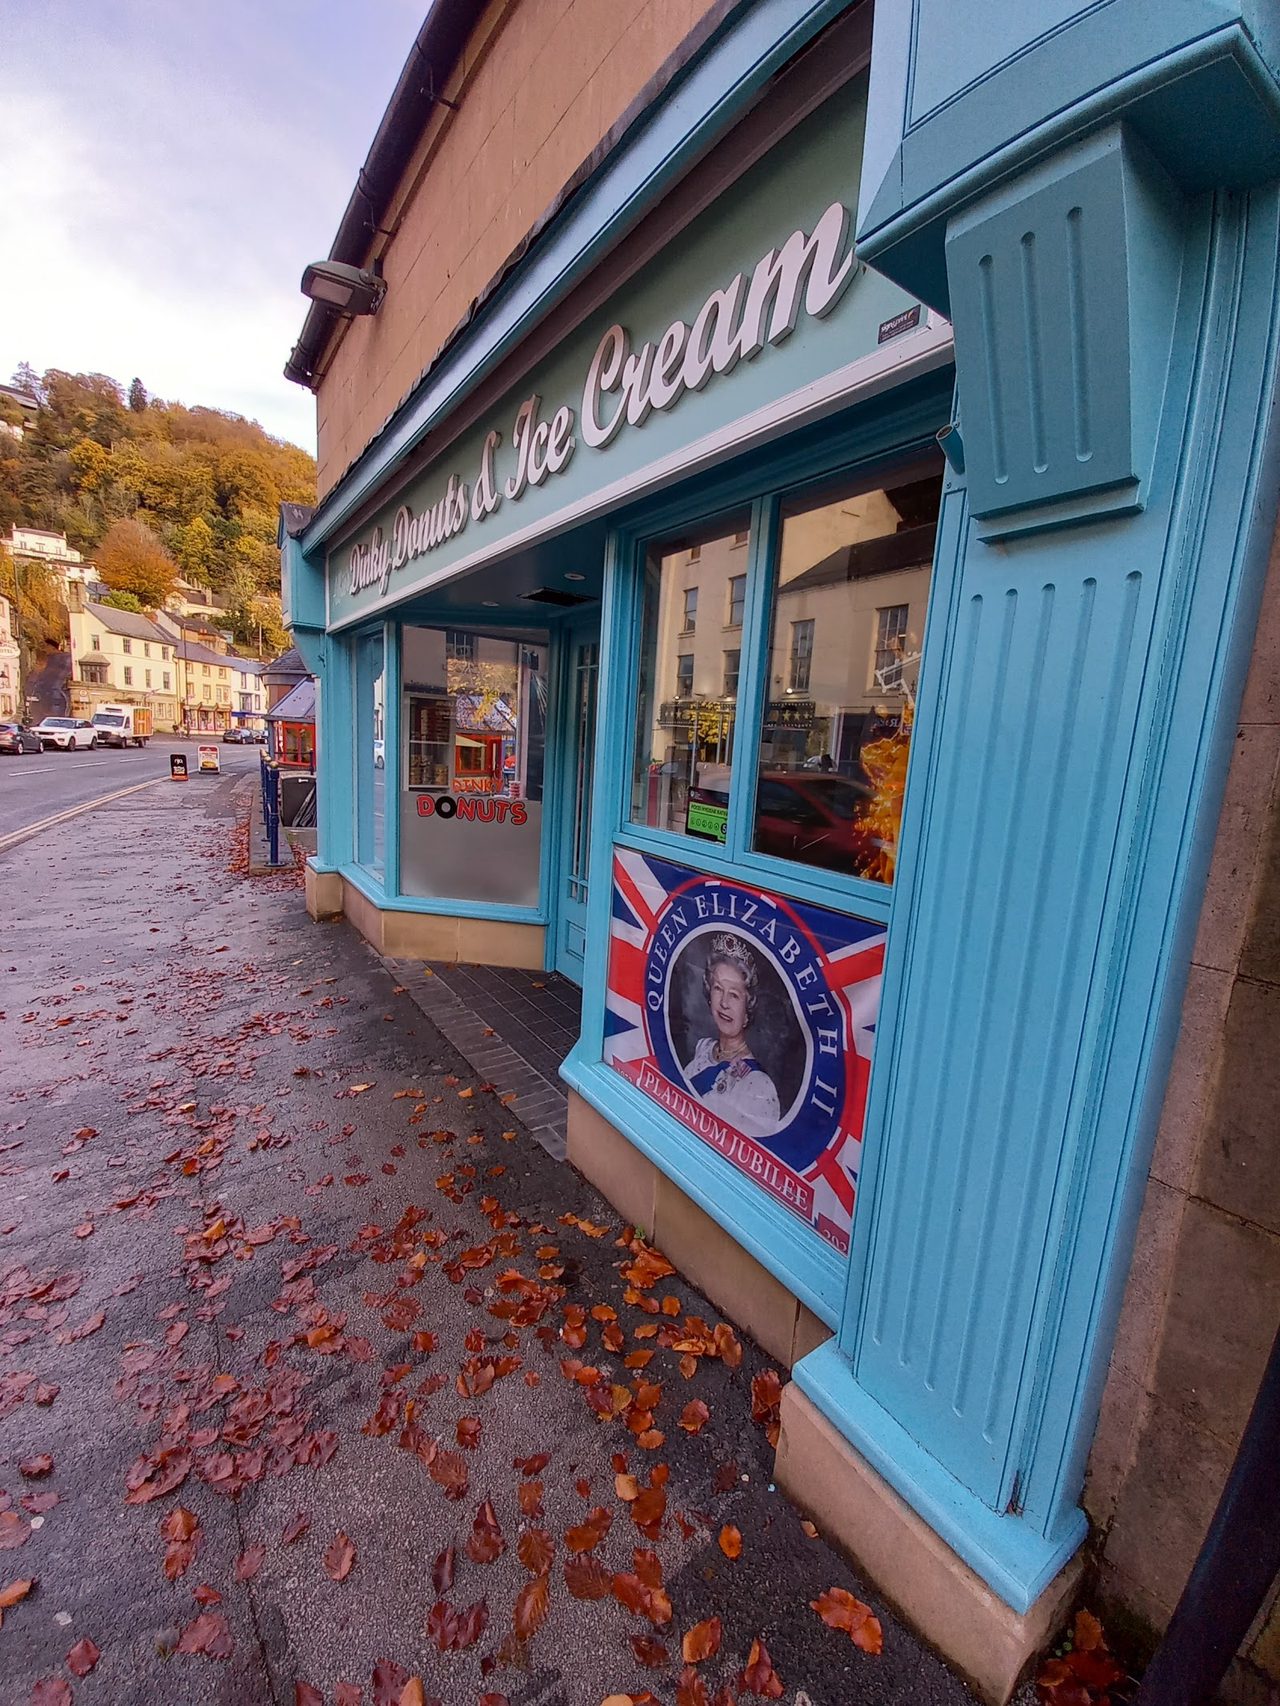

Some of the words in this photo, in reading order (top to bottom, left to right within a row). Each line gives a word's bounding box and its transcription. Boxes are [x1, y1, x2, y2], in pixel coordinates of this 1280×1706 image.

[350, 527, 392, 596] Dinky
[392, 474, 468, 570] Donuts
[504, 394, 576, 500] Ice
[581, 202, 860, 449] Cream
[416, 794, 528, 826] DONUTS
[647, 906, 690, 1013] QUEEN
[694, 892, 839, 1059] ELIZABETH
[810, 1074, 838, 1118] II
[643, 1070, 729, 1147] PLATINUM
[727, 1133, 809, 1213] JUBILEE
